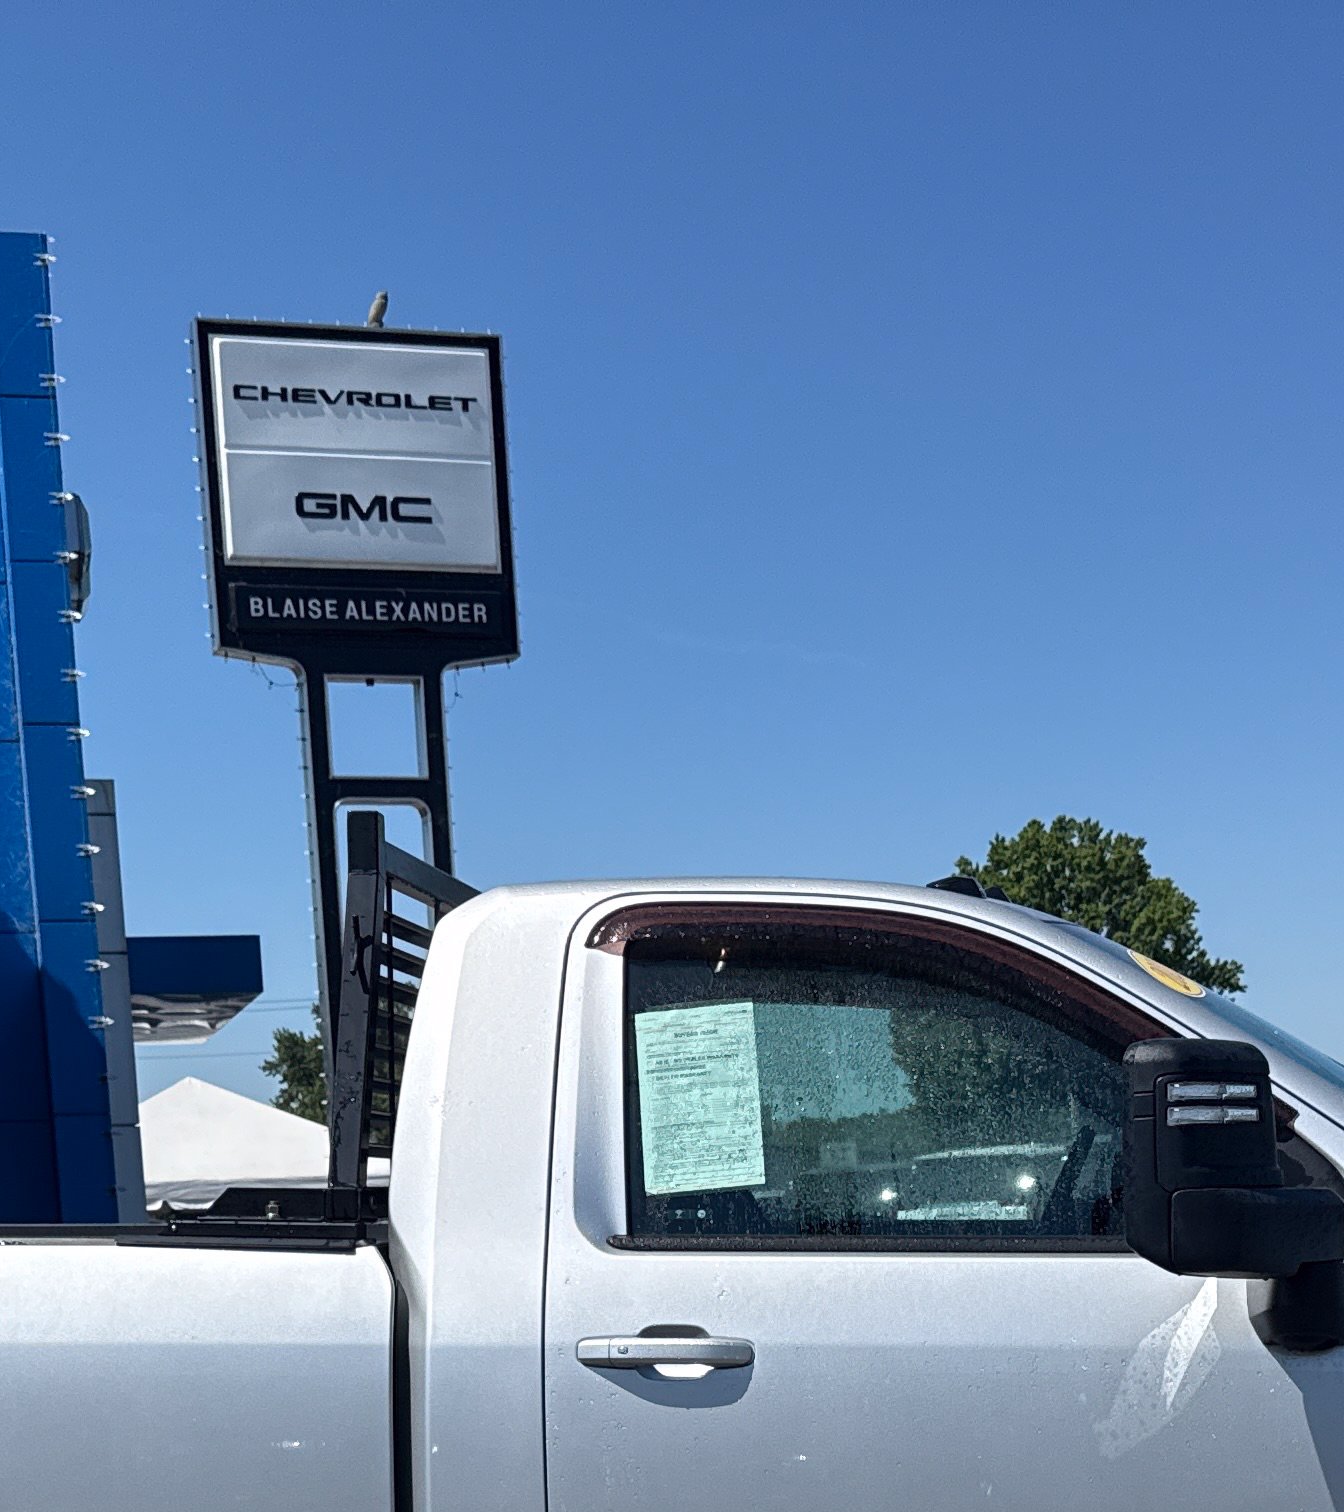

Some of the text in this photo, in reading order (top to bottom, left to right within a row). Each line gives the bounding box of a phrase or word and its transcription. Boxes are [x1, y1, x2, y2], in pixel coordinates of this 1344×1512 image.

[232, 384, 478, 413] CHEVROLET
[294, 491, 434, 524] GMC
[249, 596, 488, 624] BLAISE ALEXANDER
